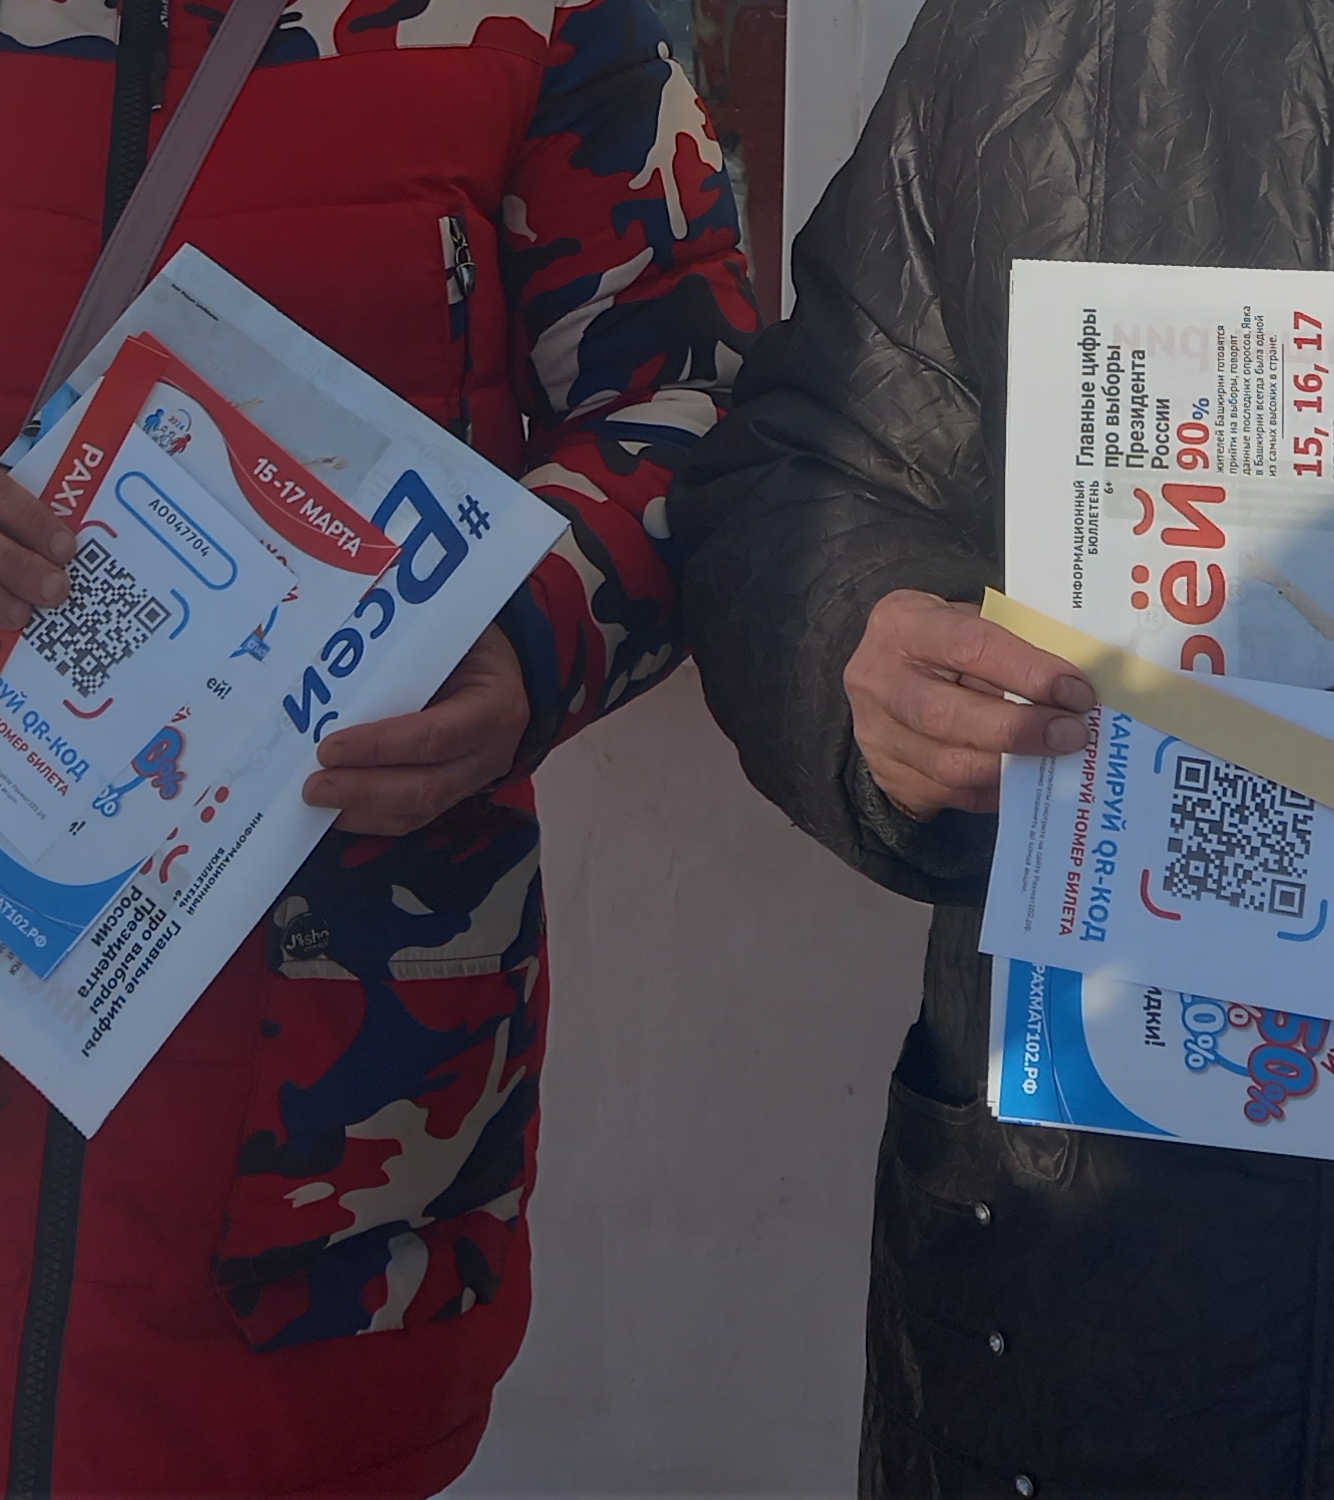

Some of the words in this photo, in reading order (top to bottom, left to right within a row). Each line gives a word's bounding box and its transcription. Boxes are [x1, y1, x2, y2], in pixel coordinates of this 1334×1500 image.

[1077, 308, 1100, 376] цифры
[1241, 306, 1251, 329] Явка
[1255, 315, 1265, 347] одной
[1293, 311, 1323, 351] 17
[1217, 325, 1225, 372] готовятся
[1230, 335, 1239, 373] говорят
[1244, 331, 1253, 375] опросов.
[1254, 349, 1264, 374] была
[1269, 335, 1279, 371] стране.
[1101, 345, 1125, 426] выборы
[1125, 349, 1148, 469] Президента
[1215, 375, 1226, 427] Башкирии
[1227, 375, 1239, 418] выборы,
[1243, 378, 1252, 432] последних
[1256, 378, 1265, 411] всегда
[1269, 382, 1277, 426] высоких
[1293, 363, 1329, 414] 16,
[167, 415, 185, 432] 2024
[1076, 382, 1095, 467] Главные
[1151, 398, 1170, 470] России
[1176, 398, 1209, 471] 90%
[1230, 421, 1238, 434] на
[1255, 413, 1265, 467] Башкирии
[1269, 429, 1277, 462] самых
[1104, 432, 1124, 468] про
[1215, 430, 1225, 474] жителей
[1229, 437, 1239, 474] прийти
[1242, 435, 1252, 475] данные
[1270, 465, 1277, 477] из
[1293, 427, 1329, 477] 15,
[1104, 481, 1114, 494] 6+
[298, 495, 365, 560] МАРТА
[1088, 480, 1099, 555] БЮЛЛЕТЕНЬ
[1072, 480, 1085, 609] ИНФОРМАЦИОННЫЙ
[14, 707, 93, 783] QR-КОД
[23, 750, 72, 797] БИЛЕТА
[1069, 808, 1090, 867] НОМЕР
[177, 846, 225, 910] БЮЛЛЕТЕНЬ
[184, 810, 263, 917] ИНФОРМАЦИОННЫЙ
[88, 882, 143, 950] России
[1058, 871, 1081, 936] БИЛЕТА
[1080, 839, 1118, 942] QR-КОД
[75, 894, 157, 1002] Президента
[138, 906, 168, 943] про
[86, 940, 145, 1016] выборы
[122, 919, 182, 996] Главные
[76, 993, 128, 1058] цифры
[1021, 962, 1046, 1095] РАХМАТ102.РФ
